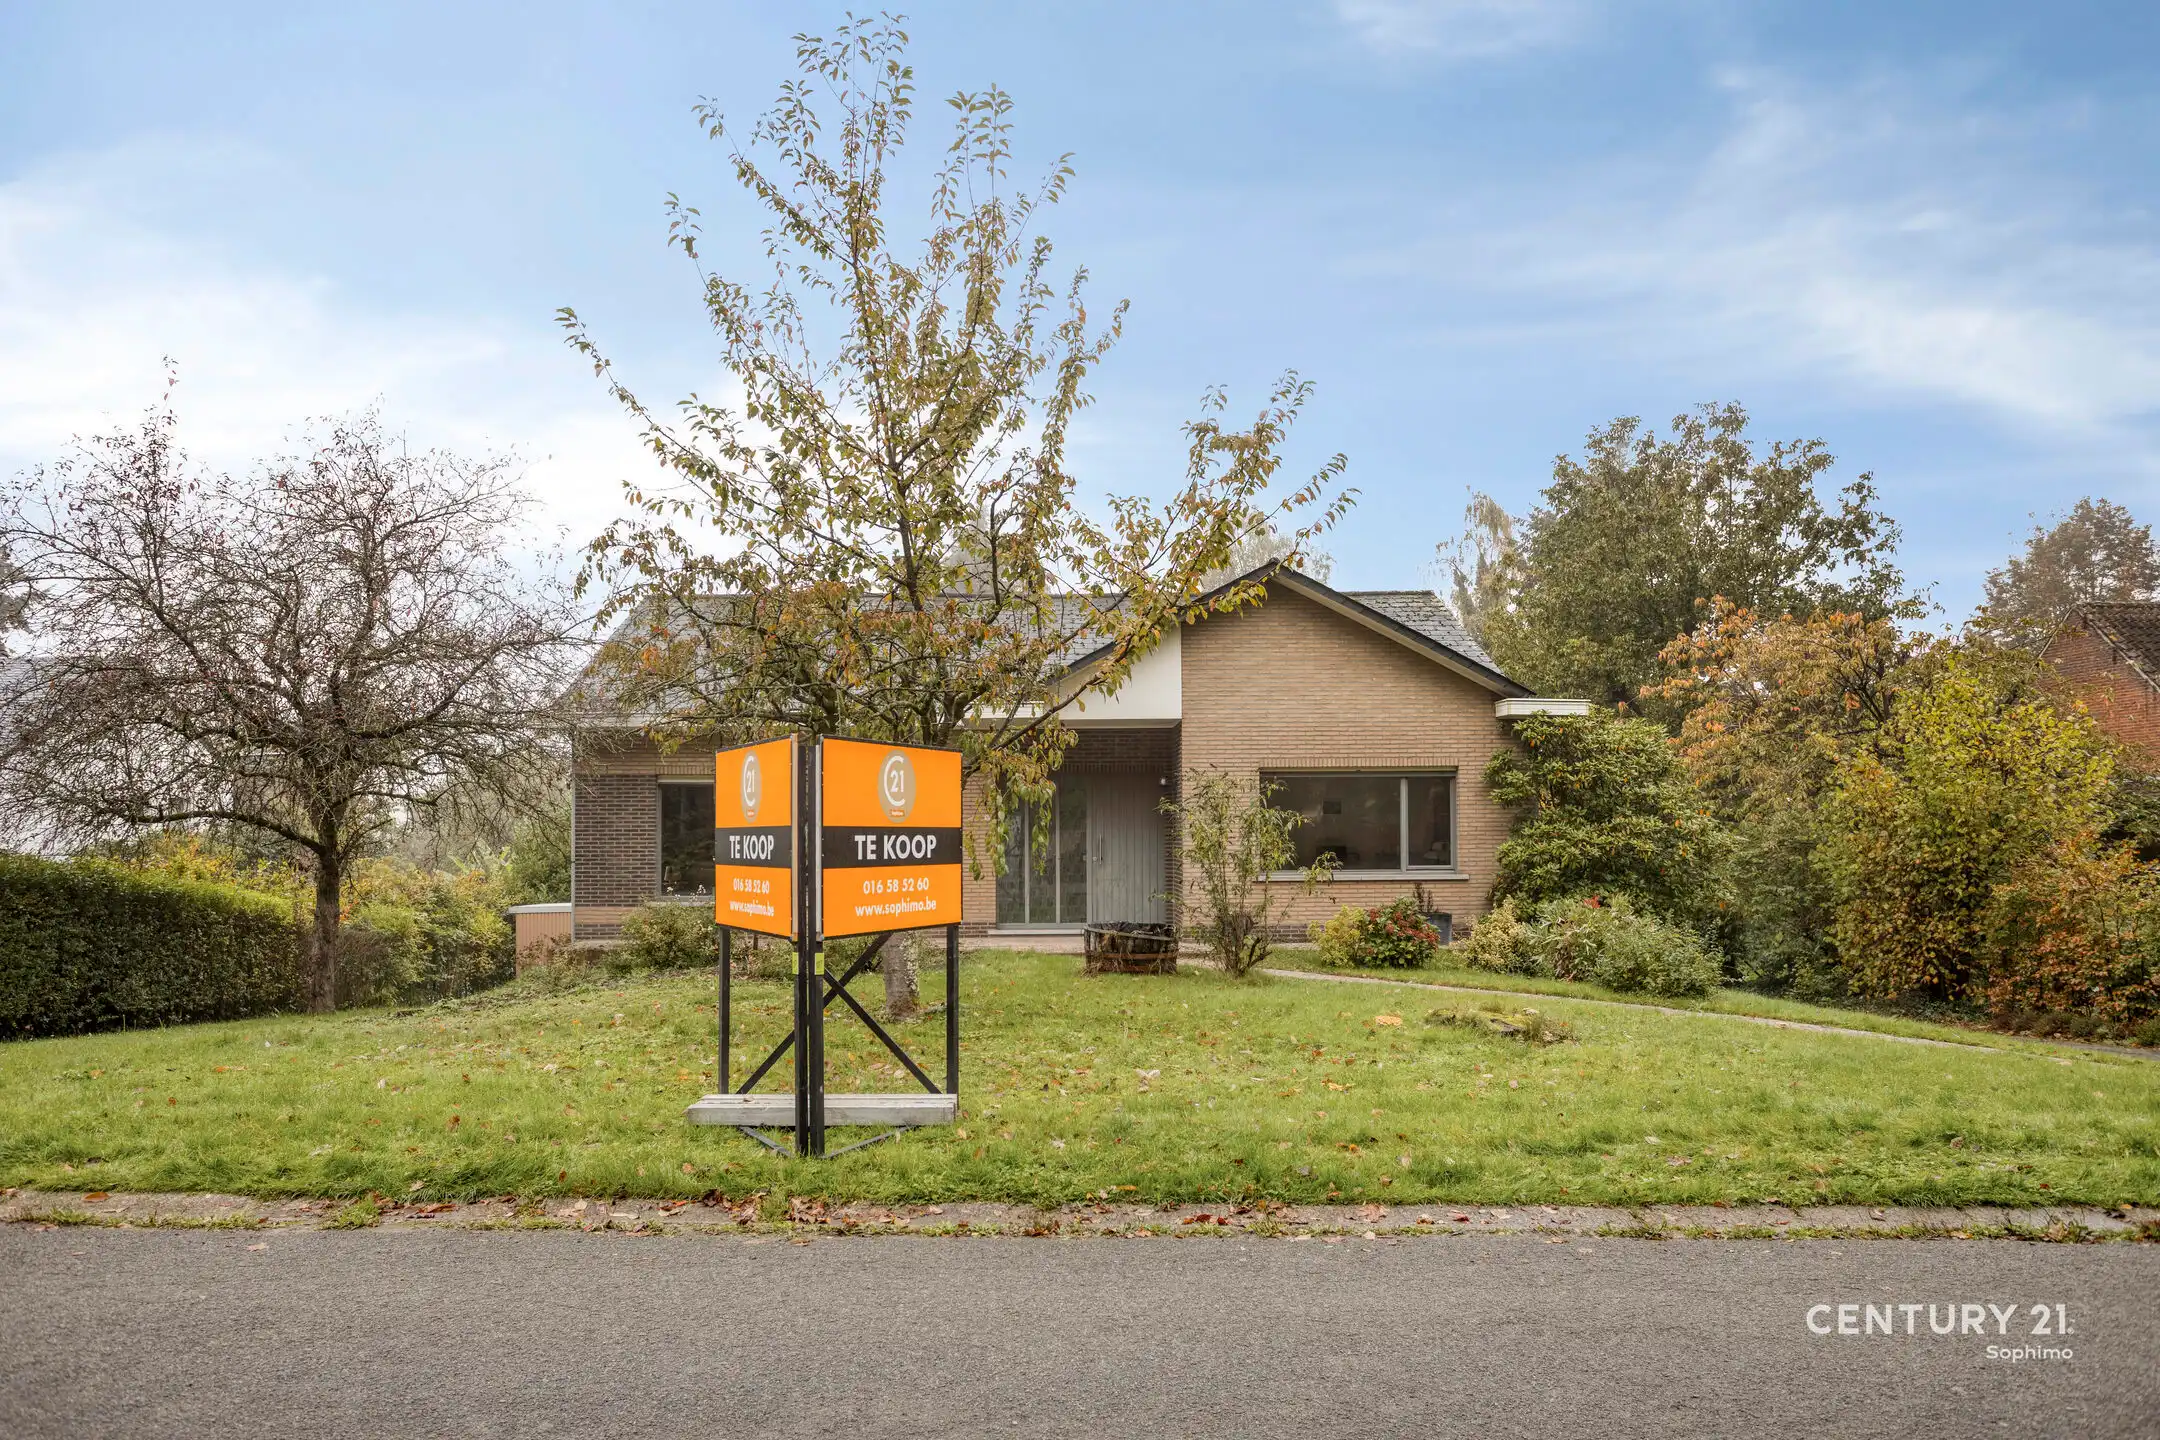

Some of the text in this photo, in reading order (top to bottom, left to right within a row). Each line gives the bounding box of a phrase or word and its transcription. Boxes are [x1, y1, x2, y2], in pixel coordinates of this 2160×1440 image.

[729, 835, 774, 860] TE KOOP
[855, 834, 937, 860] TE KOOP
[733, 878, 770, 894] 016 58 52 60
[863, 877, 929, 895] 016 58 52 60
[729, 899, 774, 917] www.sophimo.be
[855, 896, 937, 917] www.sophimo.be
